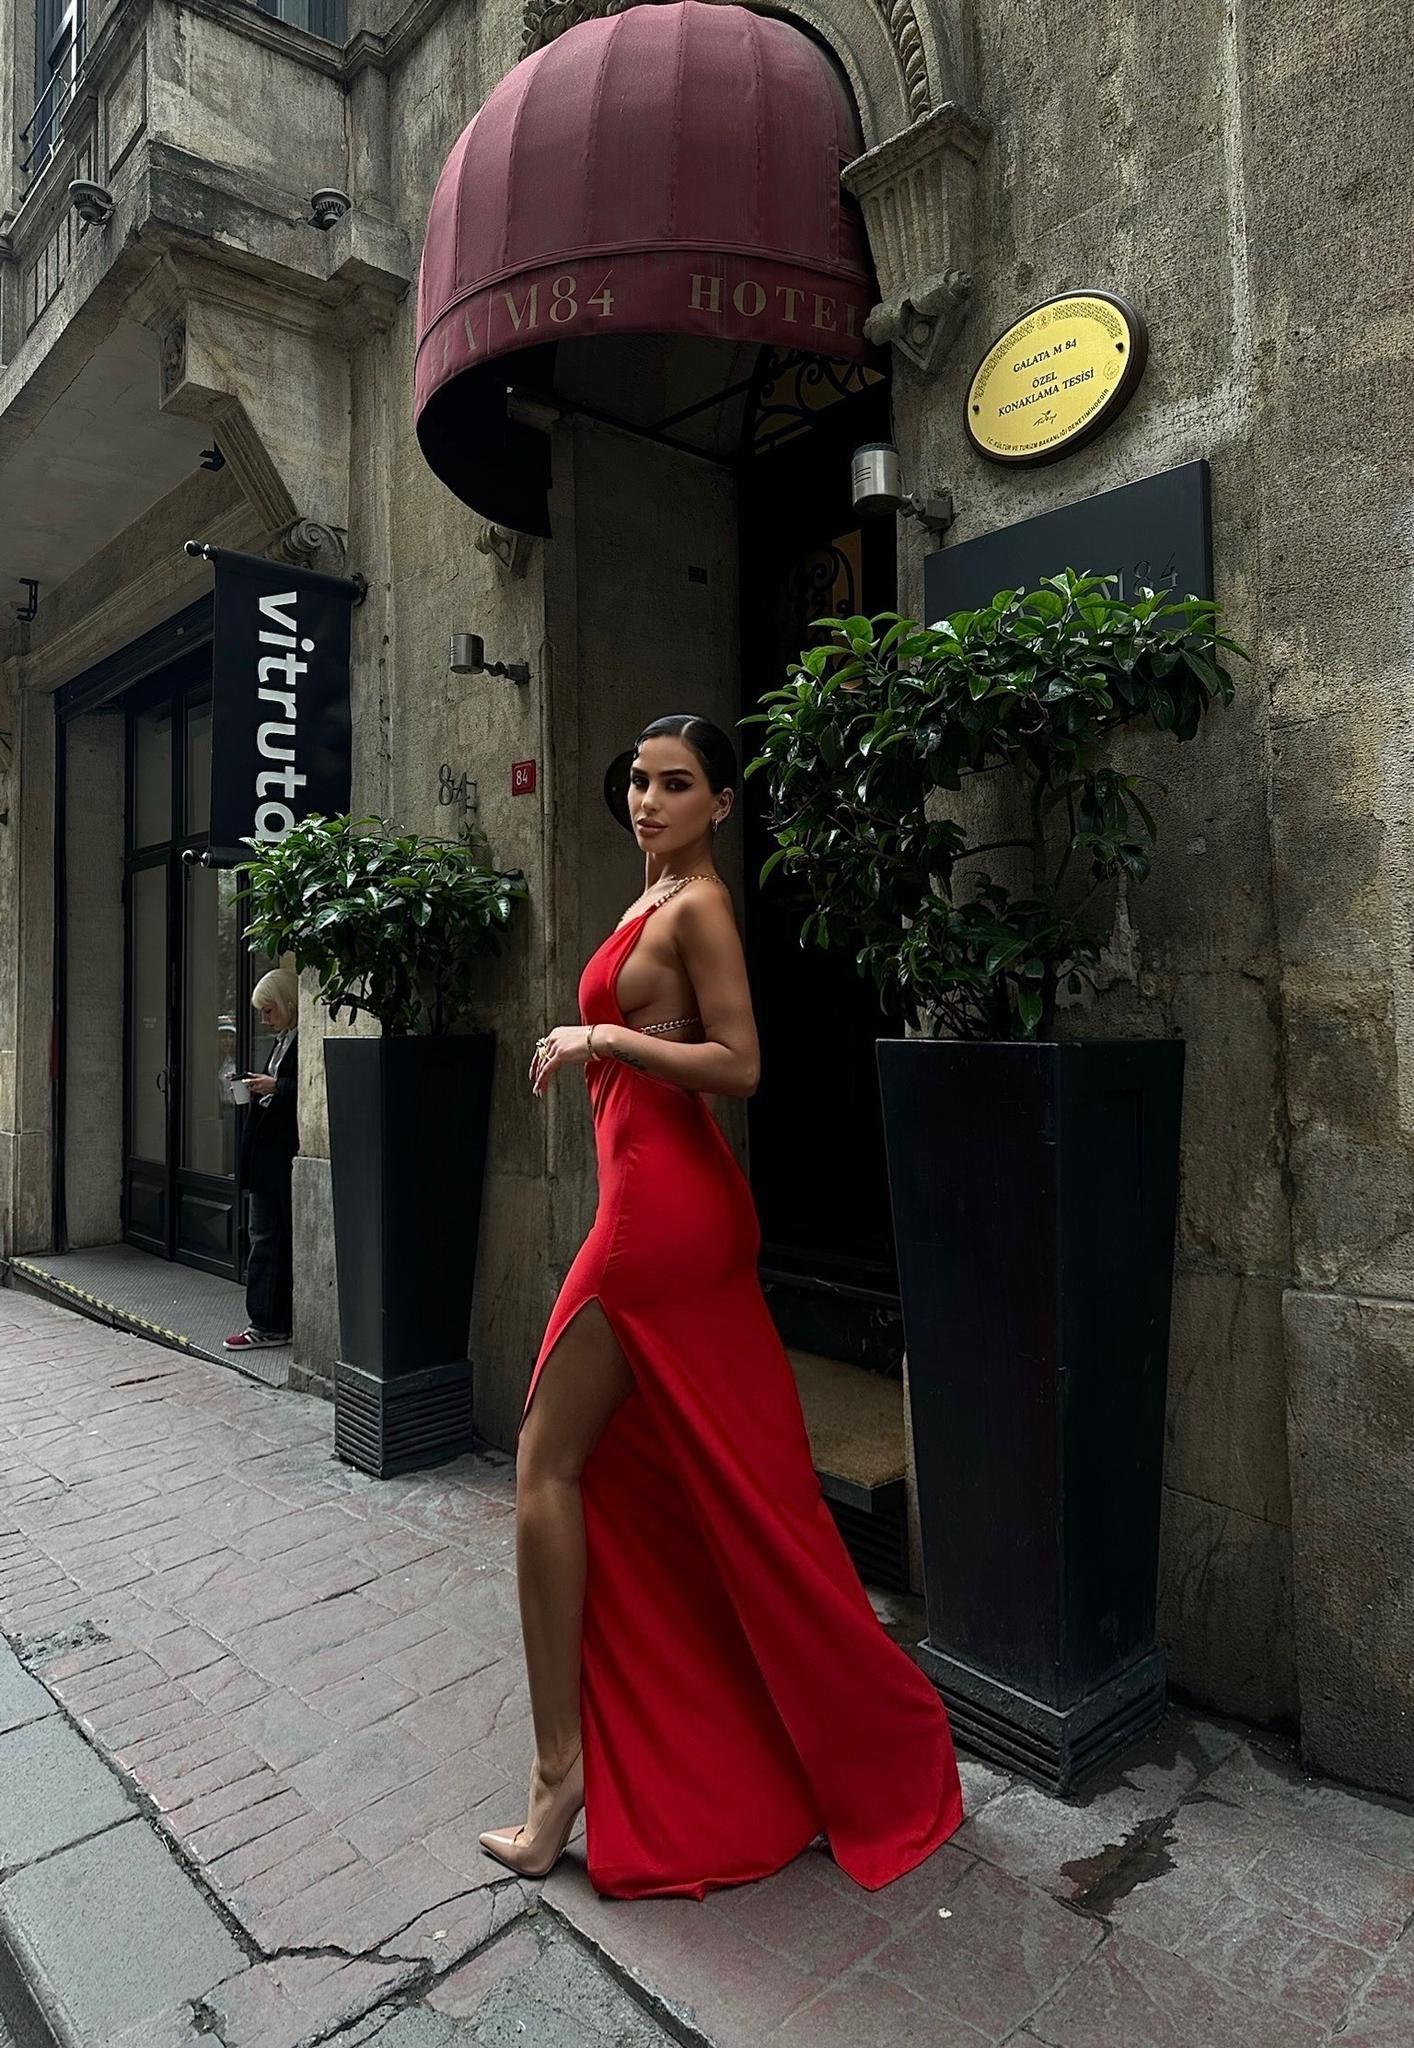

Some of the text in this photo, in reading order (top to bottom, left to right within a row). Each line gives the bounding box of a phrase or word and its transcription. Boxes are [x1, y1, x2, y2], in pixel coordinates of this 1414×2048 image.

[503, 269, 615, 332] M84
[1013, 338, 1077, 373] GALATA M 84
[998, 366, 1095, 417] KONAKLAMA TESİSİ
[1032, 371, 1058, 389] ÖZEL
[254, 591, 315, 843] vitruta
[516, 768, 528, 786] 84
